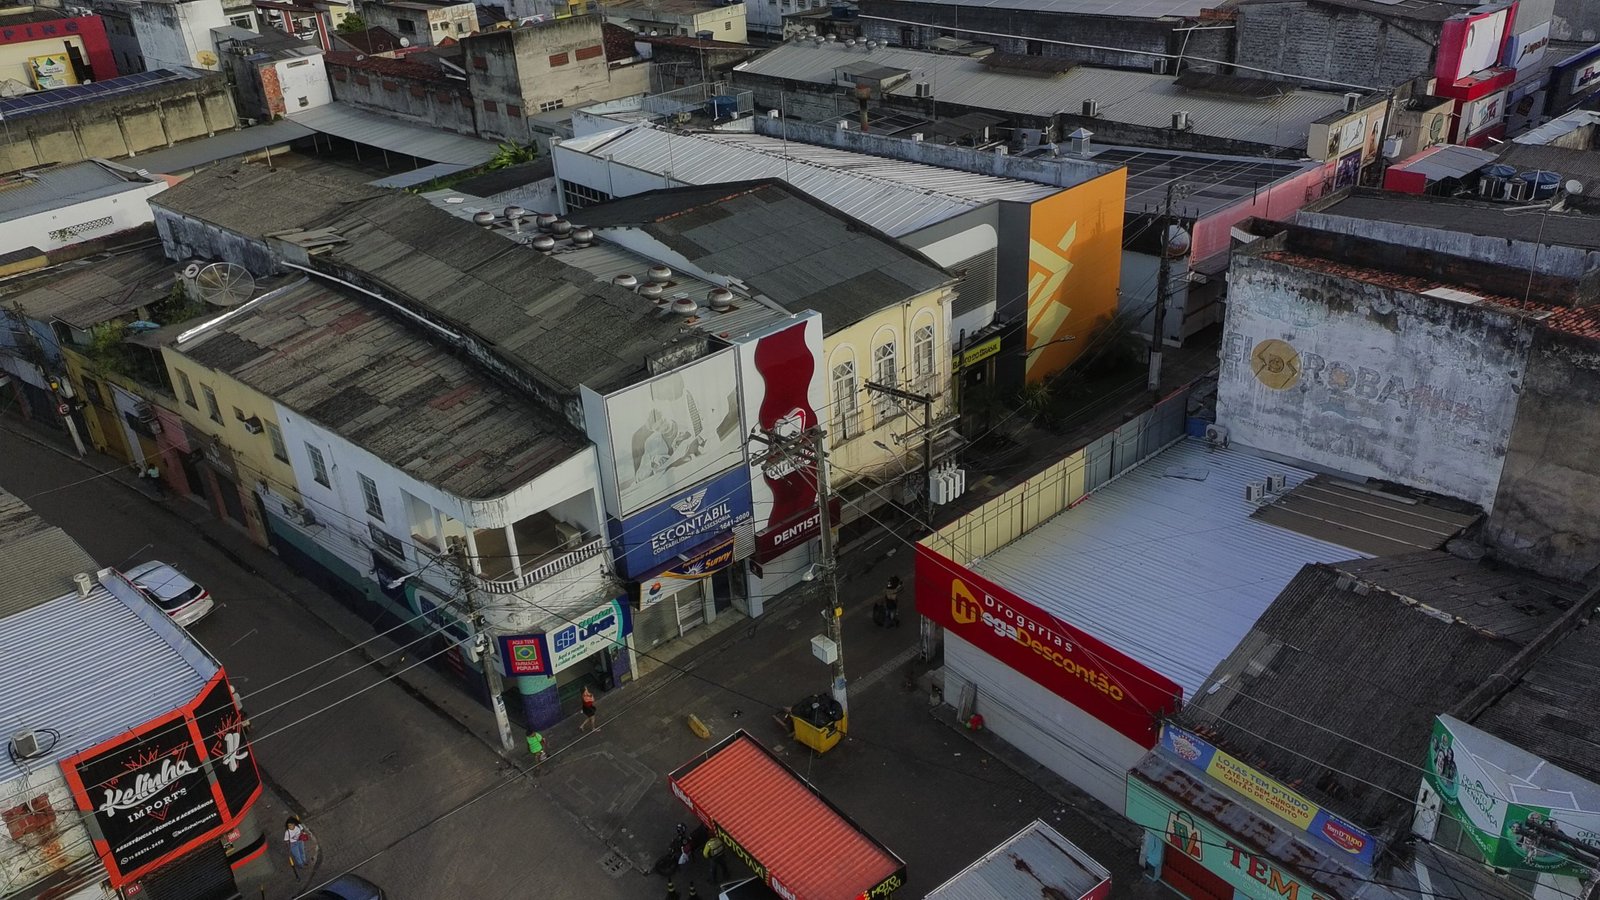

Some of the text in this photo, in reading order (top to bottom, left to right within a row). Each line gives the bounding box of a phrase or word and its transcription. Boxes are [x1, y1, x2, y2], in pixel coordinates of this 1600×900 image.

[652, 502, 731, 549] ESCONTÁBIL
[701, 514, 731, 534] ASSESSORIA
[774, 513, 822, 546] DENTIST
[705, 551, 732, 569] Sunny
[984, 594, 1073, 652] Drogarias
[99, 759, 199, 817] Kelinha
[127, 787, 188, 823] IMPORTS
[1215, 762, 1226, 772] EM
[1226, 767, 1242, 781] ATÉ
[1255, 784, 1271, 797] SEM
[1271, 795, 1296, 812] JUROS
[1296, 808, 1309, 819] NO
[1218, 755, 1309, 812] LOJAS TEM D'TUDO
[1223, 773, 1298, 819] CARTÃO DE CRÉDITO
[115, 832, 152, 852] ASSISTÊNCIA
[152, 819, 176, 834] TÉCNICA
[717, 826, 764, 879] MOTOTAXI
[872, 875, 897, 898] MOTO
[883, 879, 901, 896] TAXI
[1226, 840, 1301, 900] TEM
